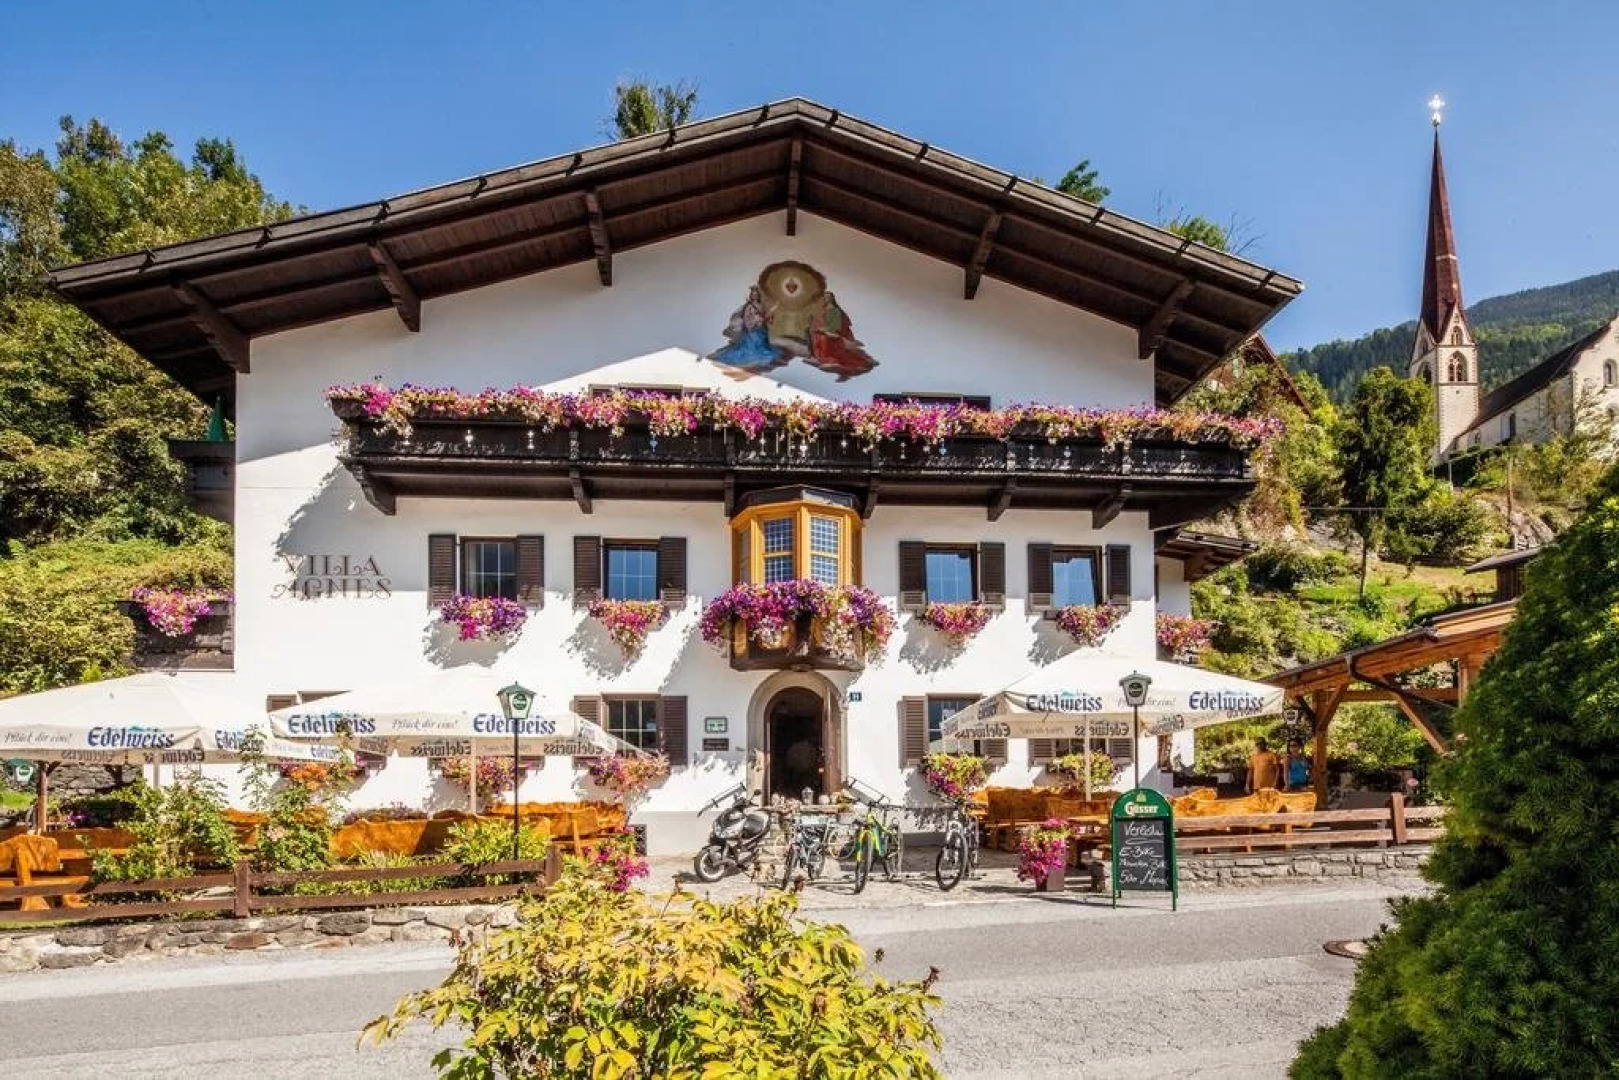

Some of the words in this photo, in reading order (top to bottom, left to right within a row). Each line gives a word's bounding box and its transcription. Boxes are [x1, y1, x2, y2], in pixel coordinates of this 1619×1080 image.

[282, 554, 383, 576] VILLA
[270, 577, 392, 601] AGNES
[1026, 692, 1103, 712] Edelweiss
[1188, 689, 1265, 712] Edelweiss
[87, 725, 175, 749] Edelweiss
